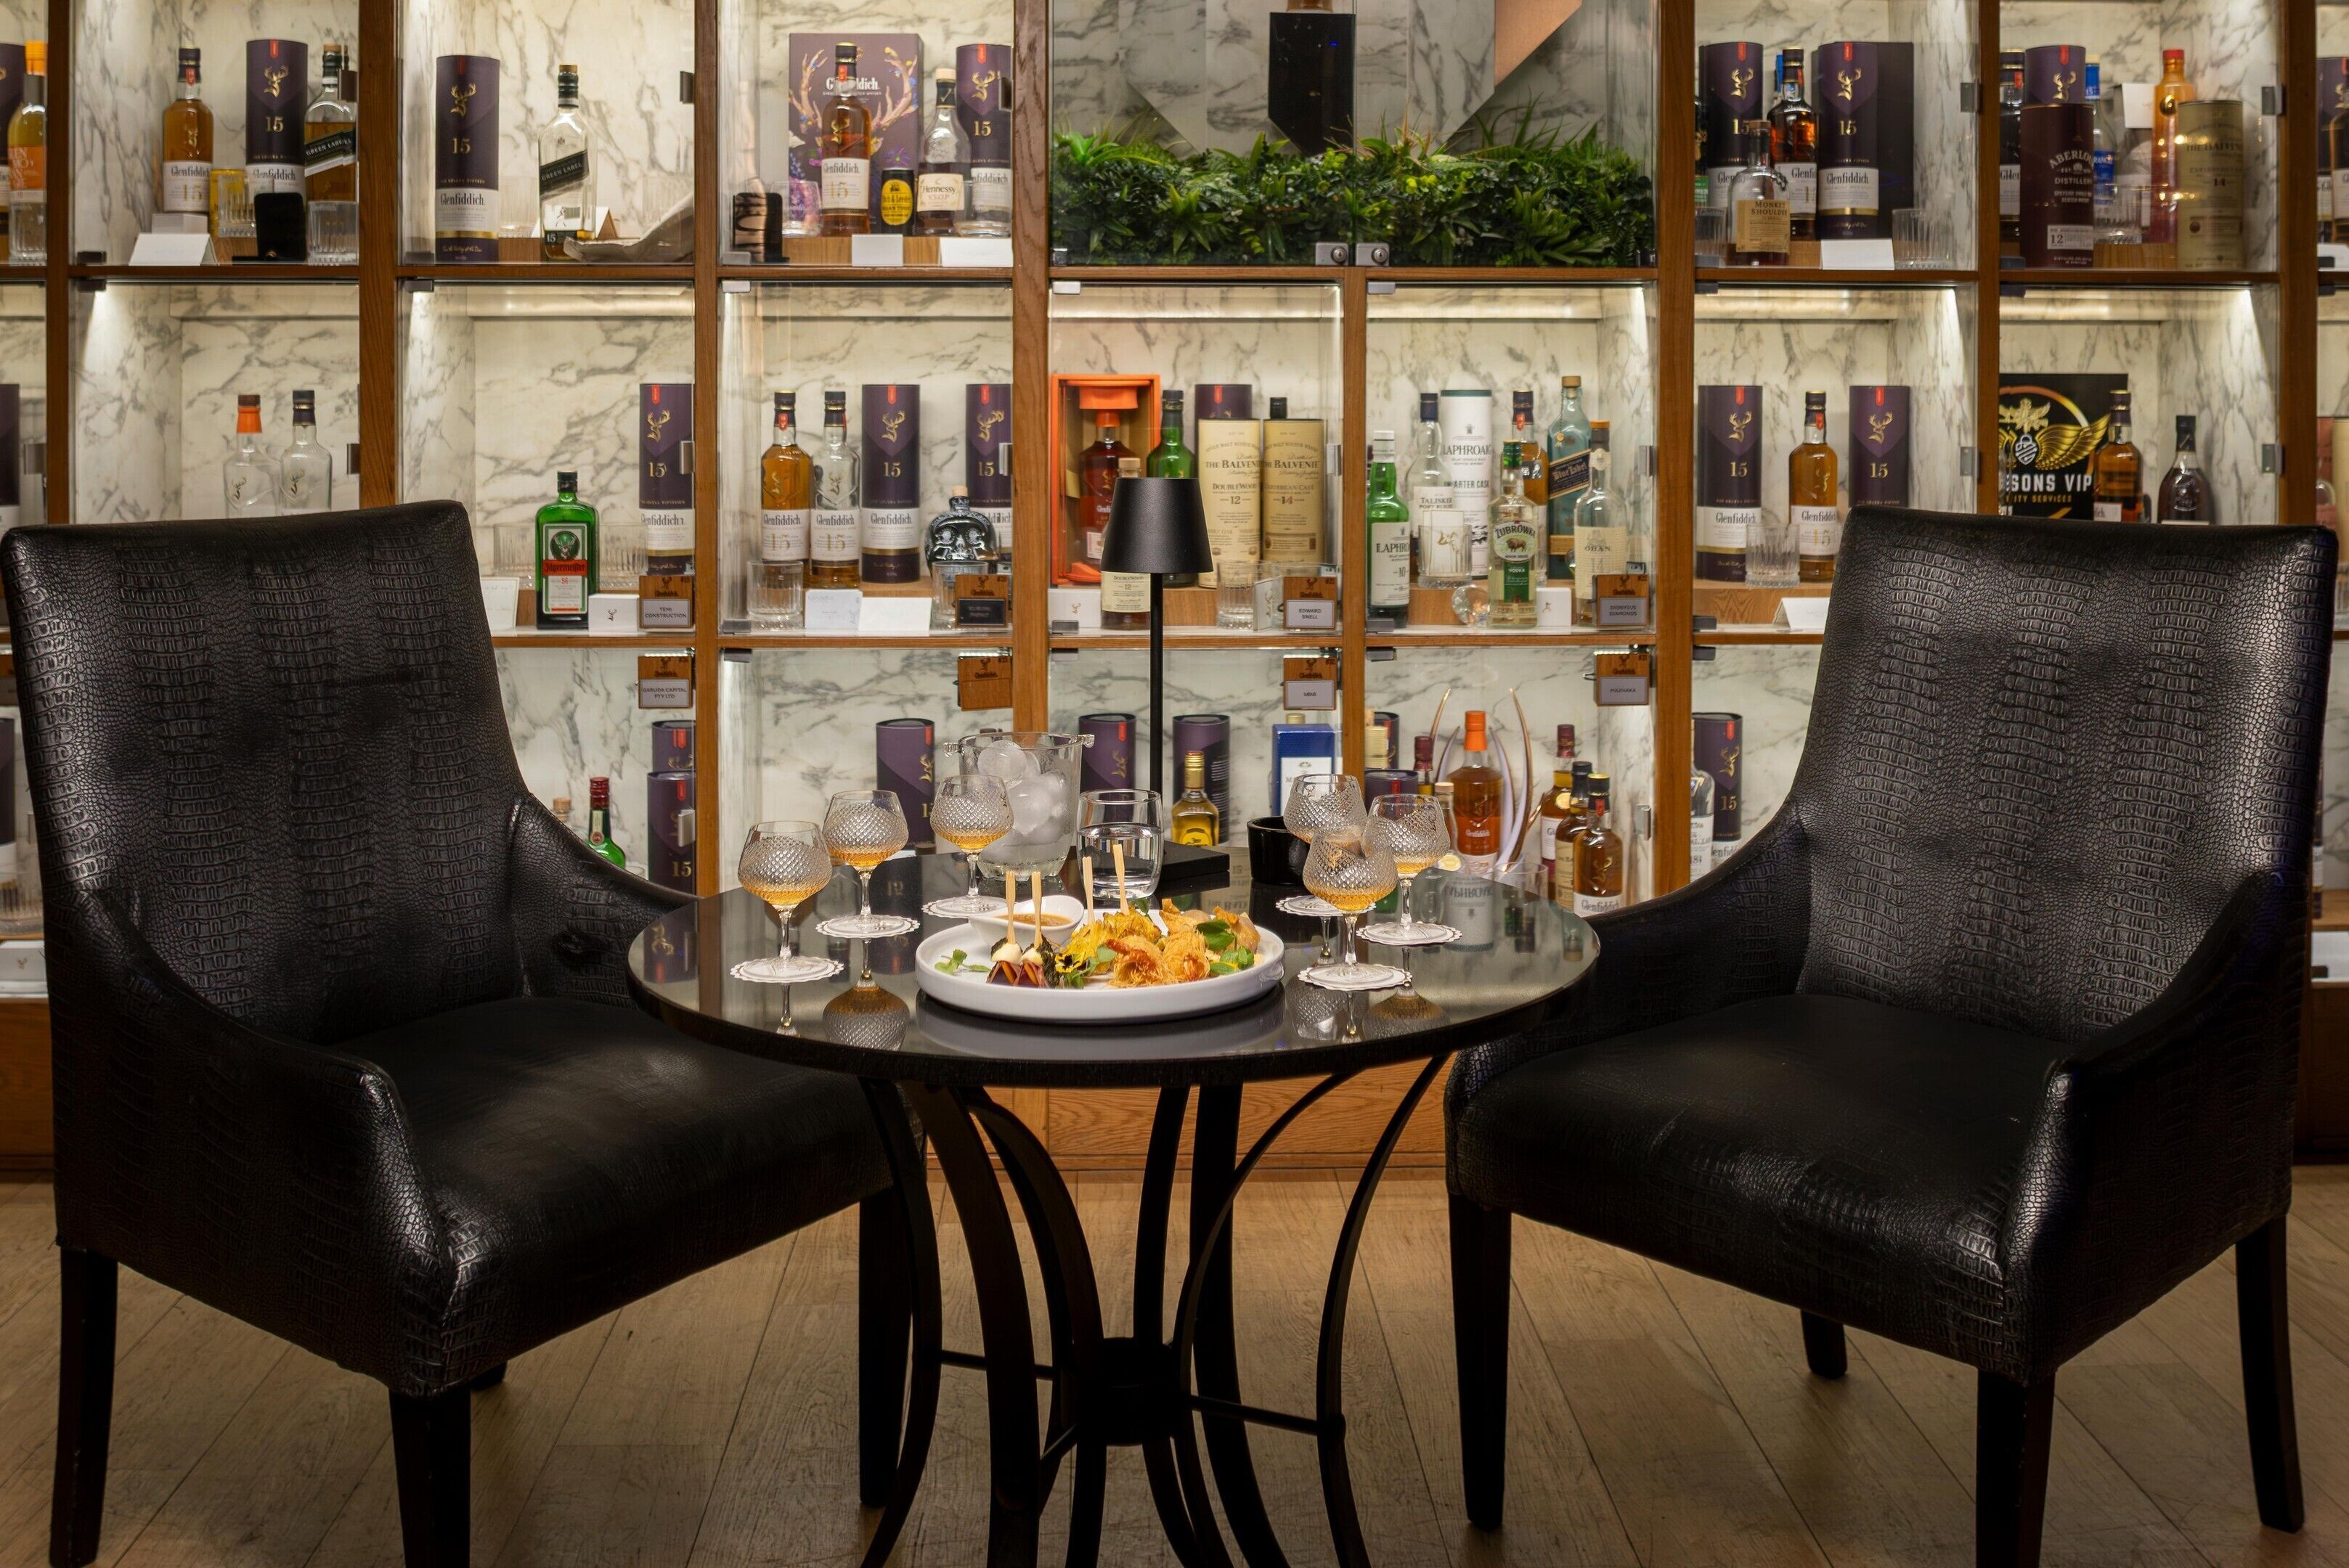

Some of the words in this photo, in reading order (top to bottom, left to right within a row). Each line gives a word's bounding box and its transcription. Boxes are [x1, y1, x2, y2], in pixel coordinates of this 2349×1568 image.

[265, 115, 284, 133] 15
[974, 121, 991, 136] 15
[1839, 120, 1857, 136] 15
[452, 137, 471, 155] 15
[542, 169, 562, 181] GREEN
[563, 162, 582, 174] LABEL
[823, 163, 860, 174] Glenfiddich
[1826, 171, 1870, 184] Glenfiddich
[183, 186, 203, 202] 15
[829, 182, 849, 199] 15
[922, 184, 956, 195] Hennessy
[440, 191, 485, 206] Glenfiddich
[547, 232, 556, 242] 15
[2051, 234, 2064, 244] 12
[648, 462, 667, 478] 15
[884, 461, 901, 478] 15
[979, 461, 995, 478] 15
[1274, 460, 1320, 470] BALVENIE
[1730, 462, 1748, 478] 15
[1870, 462, 1888, 478] 15
[2064, 473, 2093, 492] VIP
[1230, 495, 1241, 505] 12
[1281, 496, 1293, 505] 14
[2032, 494, 2072, 503] SERVICES
[763, 513, 801, 526] Glenfiddich
[816, 513, 855, 526] Glenfiddich
[871, 513, 913, 526] Glenfiddich
[1716, 511, 1757, 525] Glenfiddich
[772, 534, 791, 551] 15
[826, 534, 846, 551] 15
[1814, 528, 1831, 547] 15
[1399, 566, 1406, 578] 10
[1720, 795, 1738, 811] 15
[672, 861, 691, 877] 15
